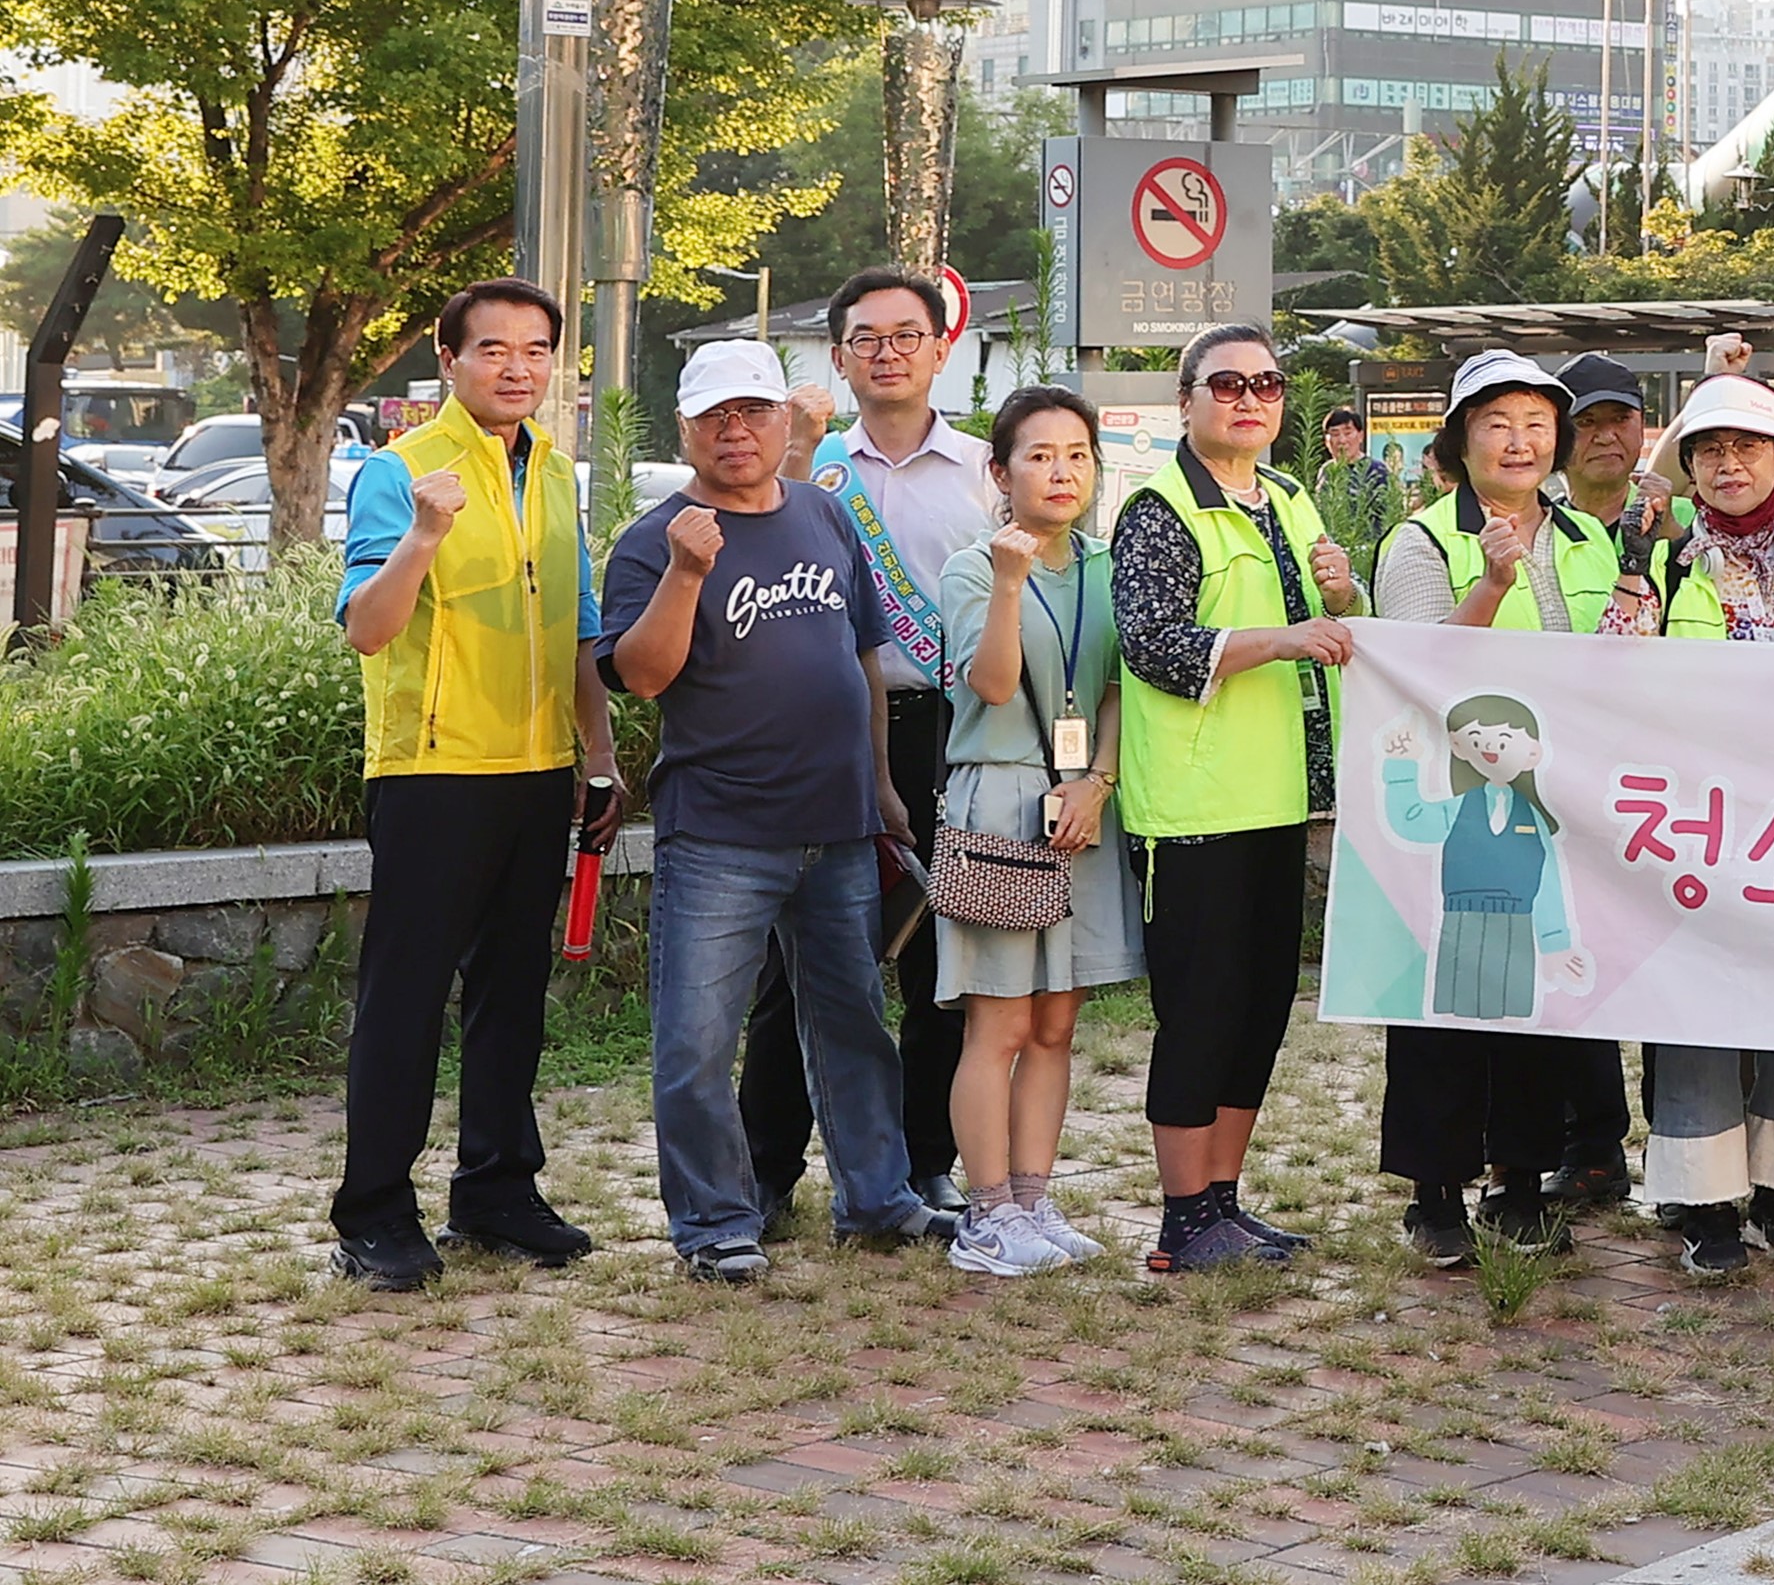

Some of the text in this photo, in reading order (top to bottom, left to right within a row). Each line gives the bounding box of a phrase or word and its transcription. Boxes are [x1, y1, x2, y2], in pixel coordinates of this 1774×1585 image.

[1120, 280, 1236, 313] 금연광장
[1133, 322, 1149, 333] NO
[1150, 322, 1195, 333] SMOKING
[726, 562, 846, 640] Seattle
[761, 605, 824, 620] SLOW LIFE
